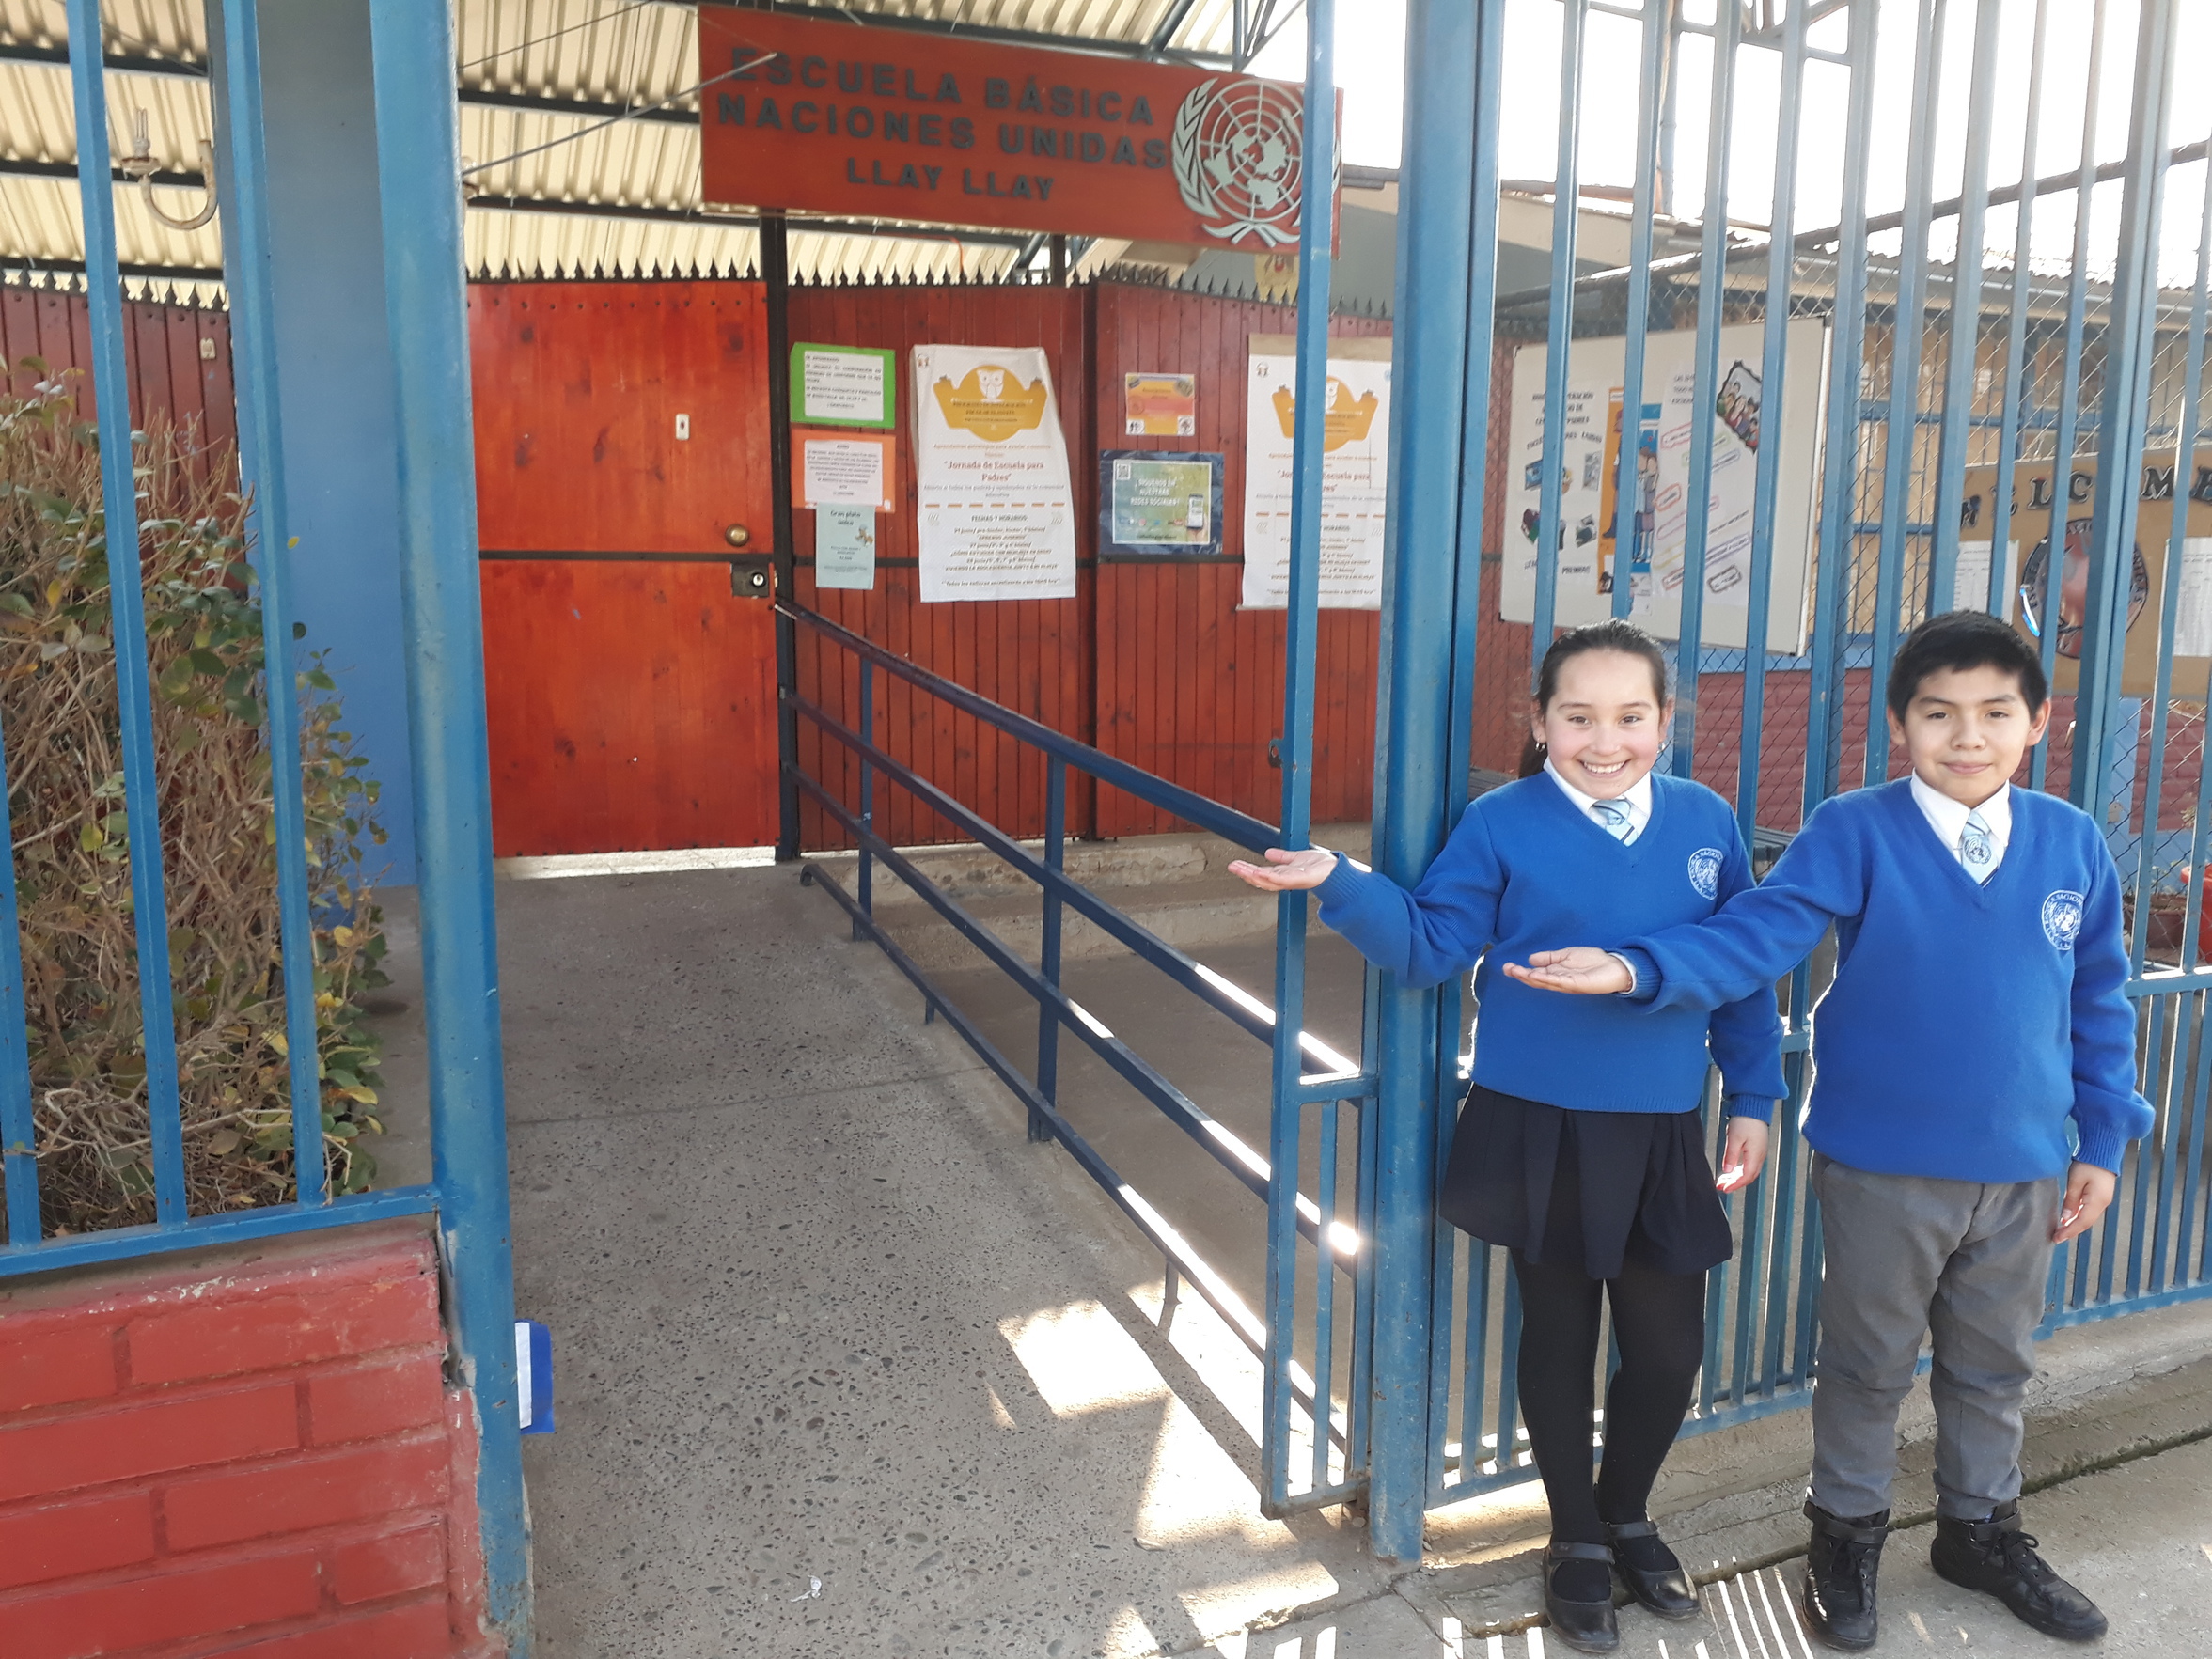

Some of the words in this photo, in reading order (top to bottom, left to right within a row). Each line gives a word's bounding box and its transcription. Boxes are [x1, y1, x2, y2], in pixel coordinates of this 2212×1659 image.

[731, 47, 962, 104] ESCUELA
[718, 94, 975, 150] NACIONES
[999, 124, 1168, 170] UNIDAS
[847, 157, 943, 191] LLAY
[964, 169, 1055, 201] LLAY
[994, 461, 1026, 469] Escuela
[1028, 462, 1044, 471] para
